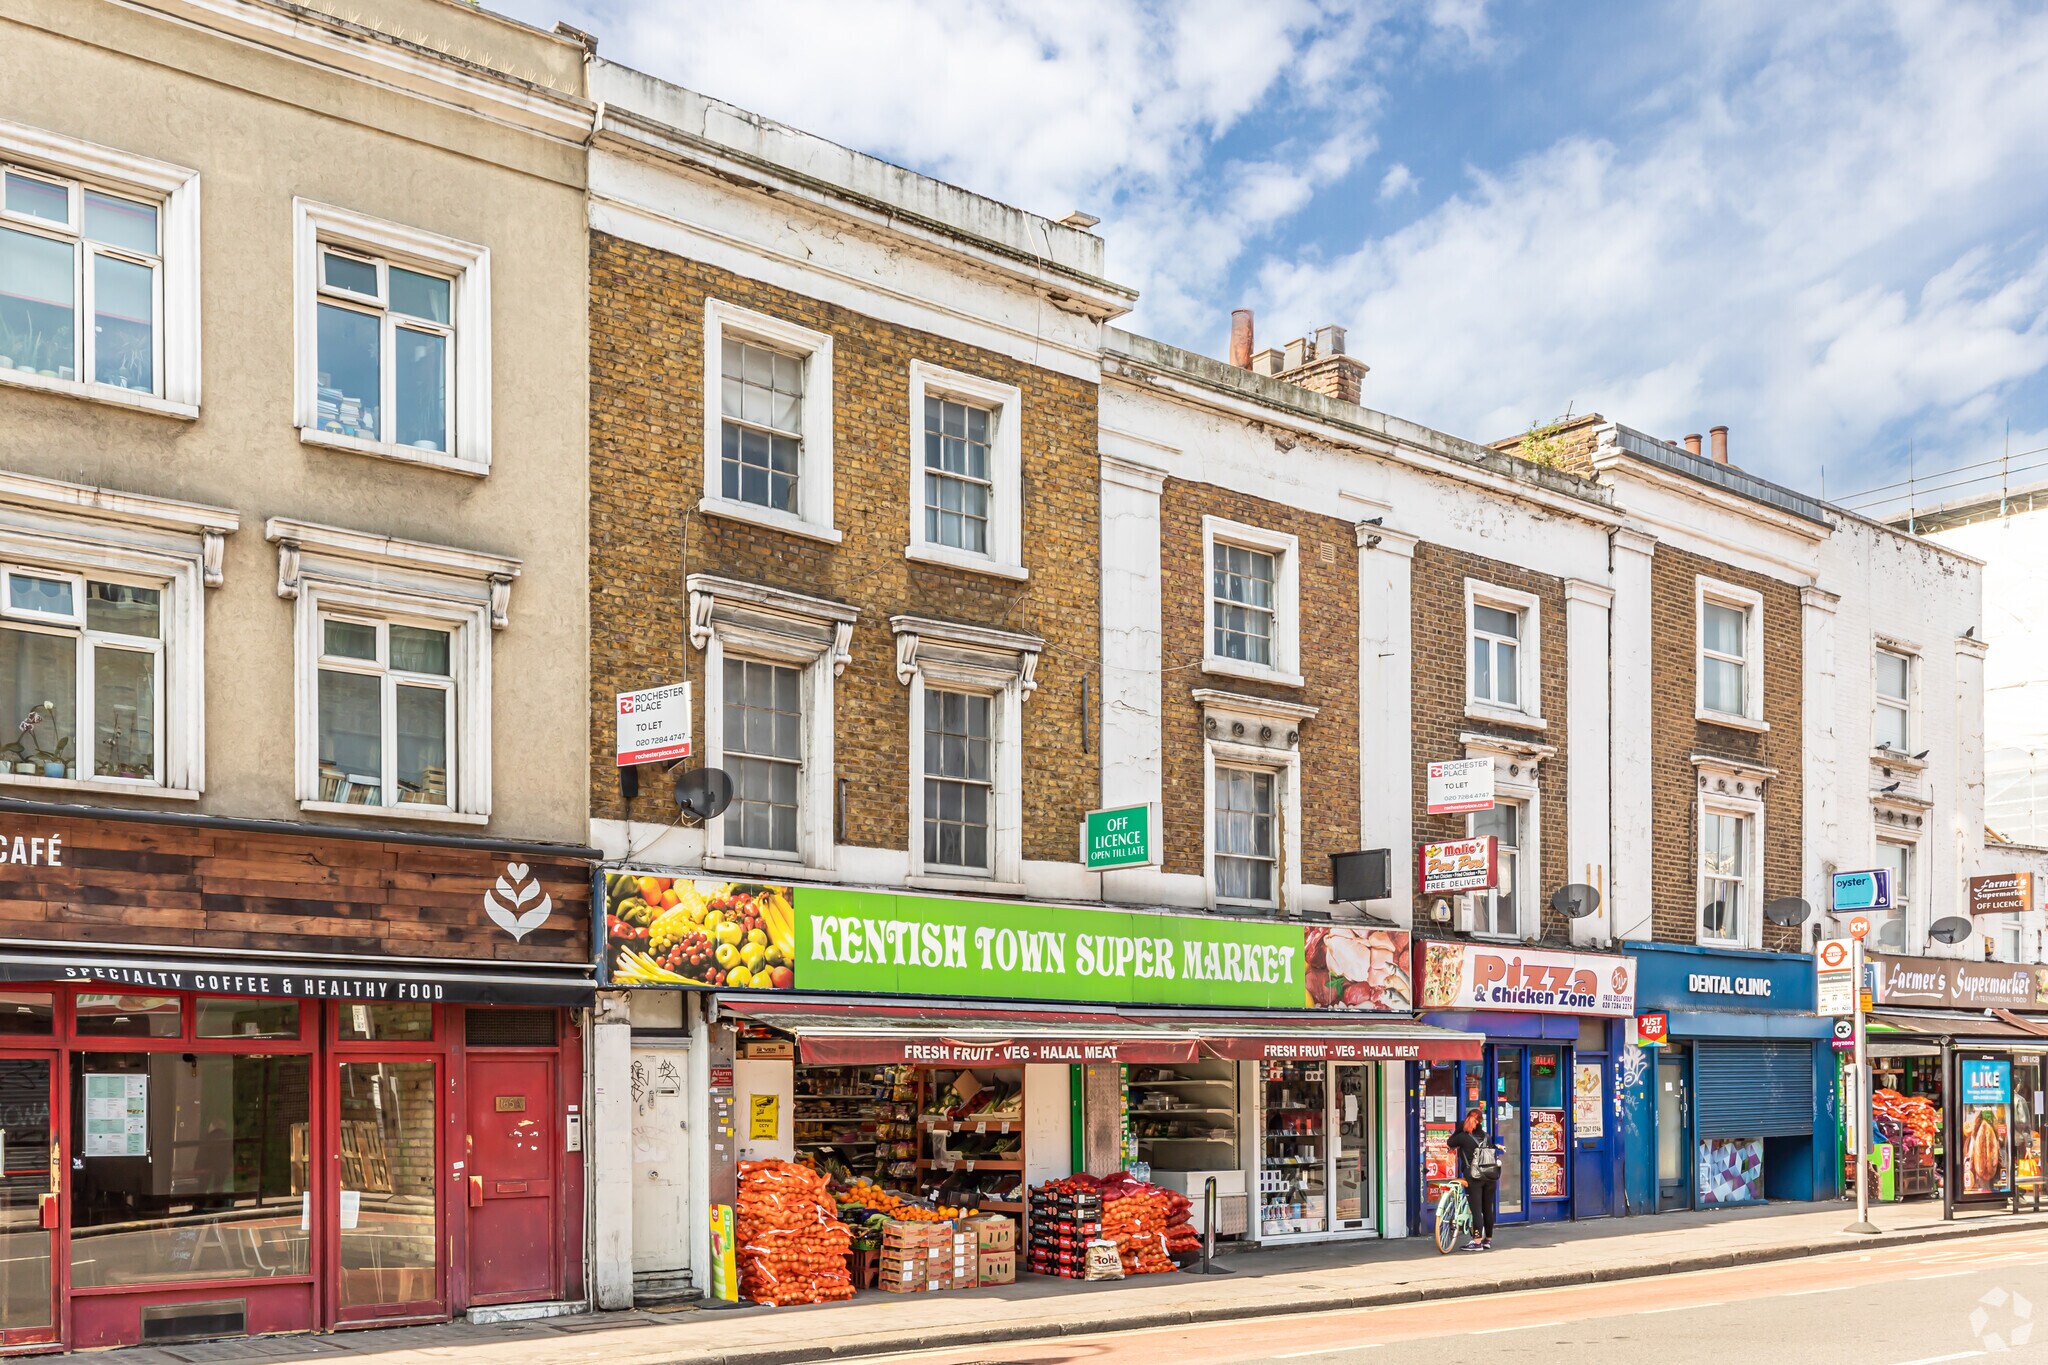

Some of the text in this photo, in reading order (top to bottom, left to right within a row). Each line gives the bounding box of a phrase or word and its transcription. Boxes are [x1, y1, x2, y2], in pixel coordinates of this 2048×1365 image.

[634, 686, 684, 703] ROCHESTER
[635, 700, 662, 713] PLACE
[636, 720, 663, 732] TO LET
[635, 732, 686, 747] 020 7284 4747
[635, 746, 686, 760] rochesterplace.co.uk
[1443, 760, 1488, 771] ROCHESTER
[1443, 769, 1468, 777] PLACE
[1455, 781, 1469, 789] LET
[1443, 802, 1489, 811] rochesterplace.co.uk
[1107, 816, 1129, 832] OFF
[1095, 830, 1141, 849] LICENCE
[1090, 845, 1145, 861] OPEN TILL LATE
[1426, 877, 1486, 890] FREE DELIVERY
[1836, 877, 1867, 890] oyster
[1974, 889, 2028, 901] Supermarket
[1976, 899, 2024, 910] OFF LICENCE
[1850, 921, 1868, 932] KM
[810, 914, 1295, 985] KENTISH TOWN SUPER MARKET
[1473, 954, 1598, 998] Pizza
[65, 967, 444, 1000] SPECIALTY COFFEE & HEALTHY FOOD
[1688, 973, 1772, 997] DENTAL CLINIC
[1951, 967, 2030, 1001] Supermarket
[1474, 985, 1596, 1008] & Chicken Zone
[1613, 995, 1633, 1003] DELIVERY
[1641, 1017, 1663, 1035] JUST EAT
[1264, 1044, 1297, 1057] FRESH
[1299, 1045, 1328, 1057] FRUIT
[1335, 1044, 1355, 1057] VEG
[1363, 1045, 1393, 1057] HALAL
[1395, 1045, 1419, 1057] MEAT
[1832, 1040, 1855, 1048] payzone
[904, 1045, 950, 1060] FRESH
[953, 1046, 994, 1061] FRUIT
[1003, 1045, 1030, 1060] VEG
[1040, 1045, 1082, 1059] HALAL
[1084, 1045, 1118, 1059] MEAT
[1971, 1071, 2000, 1089] LIKE
[1539, 1111, 1557, 1122] Pizza
